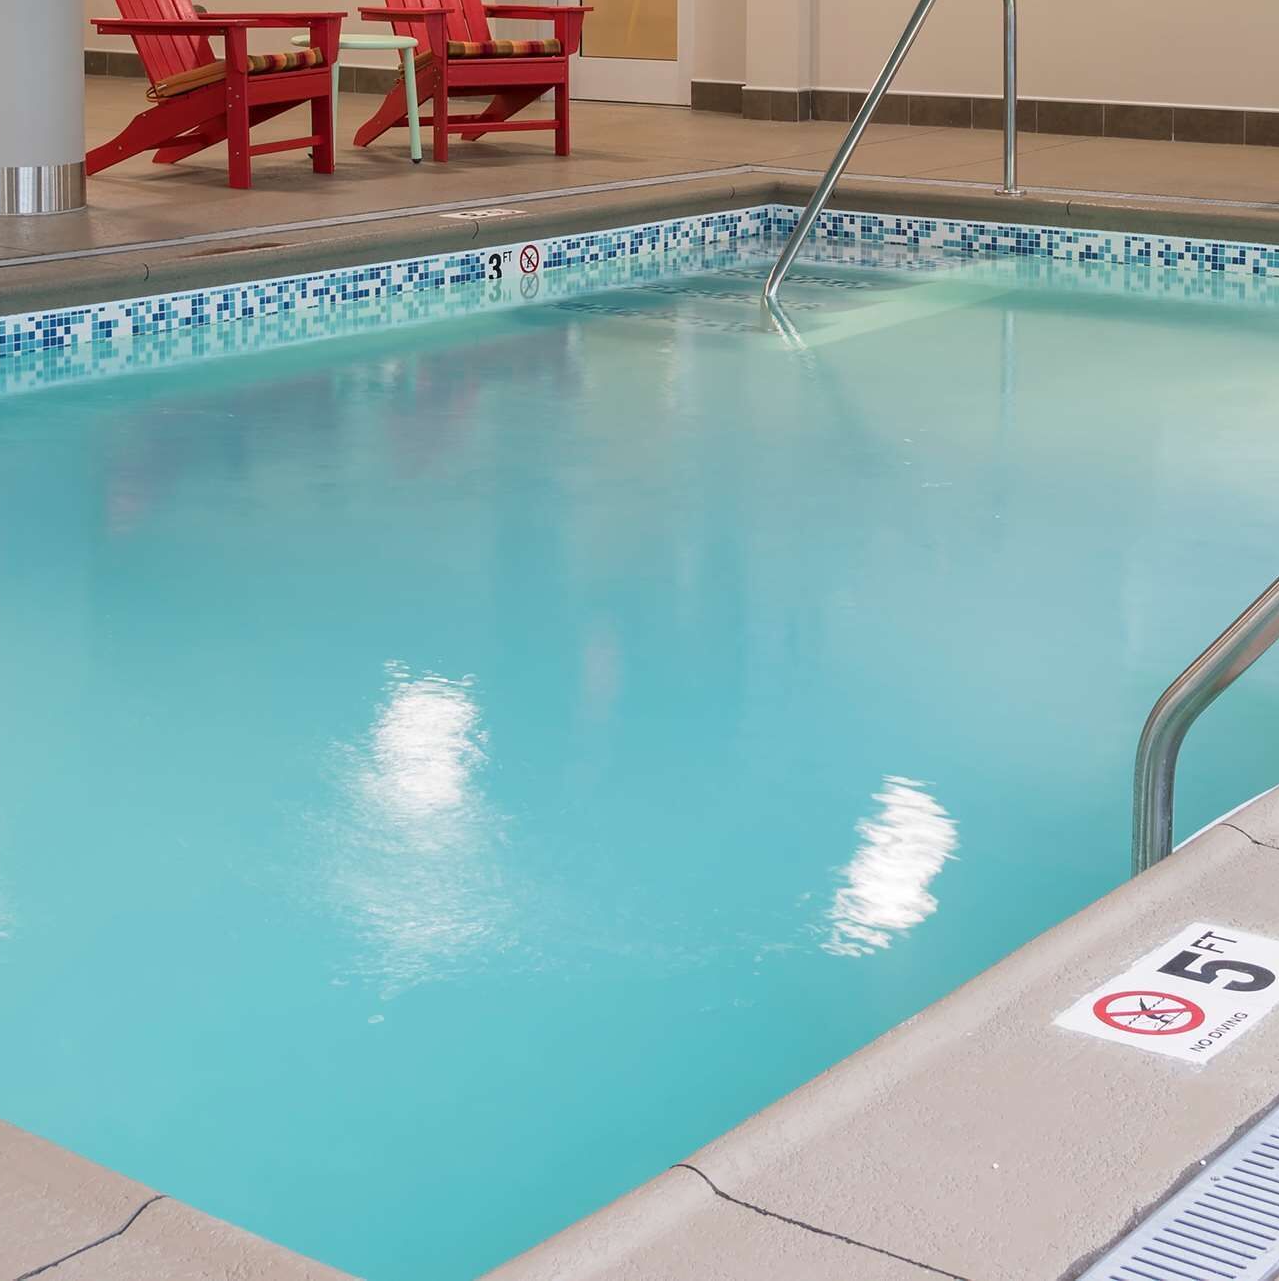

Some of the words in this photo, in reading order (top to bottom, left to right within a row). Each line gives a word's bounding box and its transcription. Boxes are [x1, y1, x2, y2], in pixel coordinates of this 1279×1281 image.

[489, 253, 502, 279] 3
[503, 250, 512, 262] FT
[1190, 930, 1238, 954] FT
[1157, 950, 1276, 992] 5
[1189, 1039, 1213, 1052] NO
[1208, 1012, 1248, 1038] DIVING
